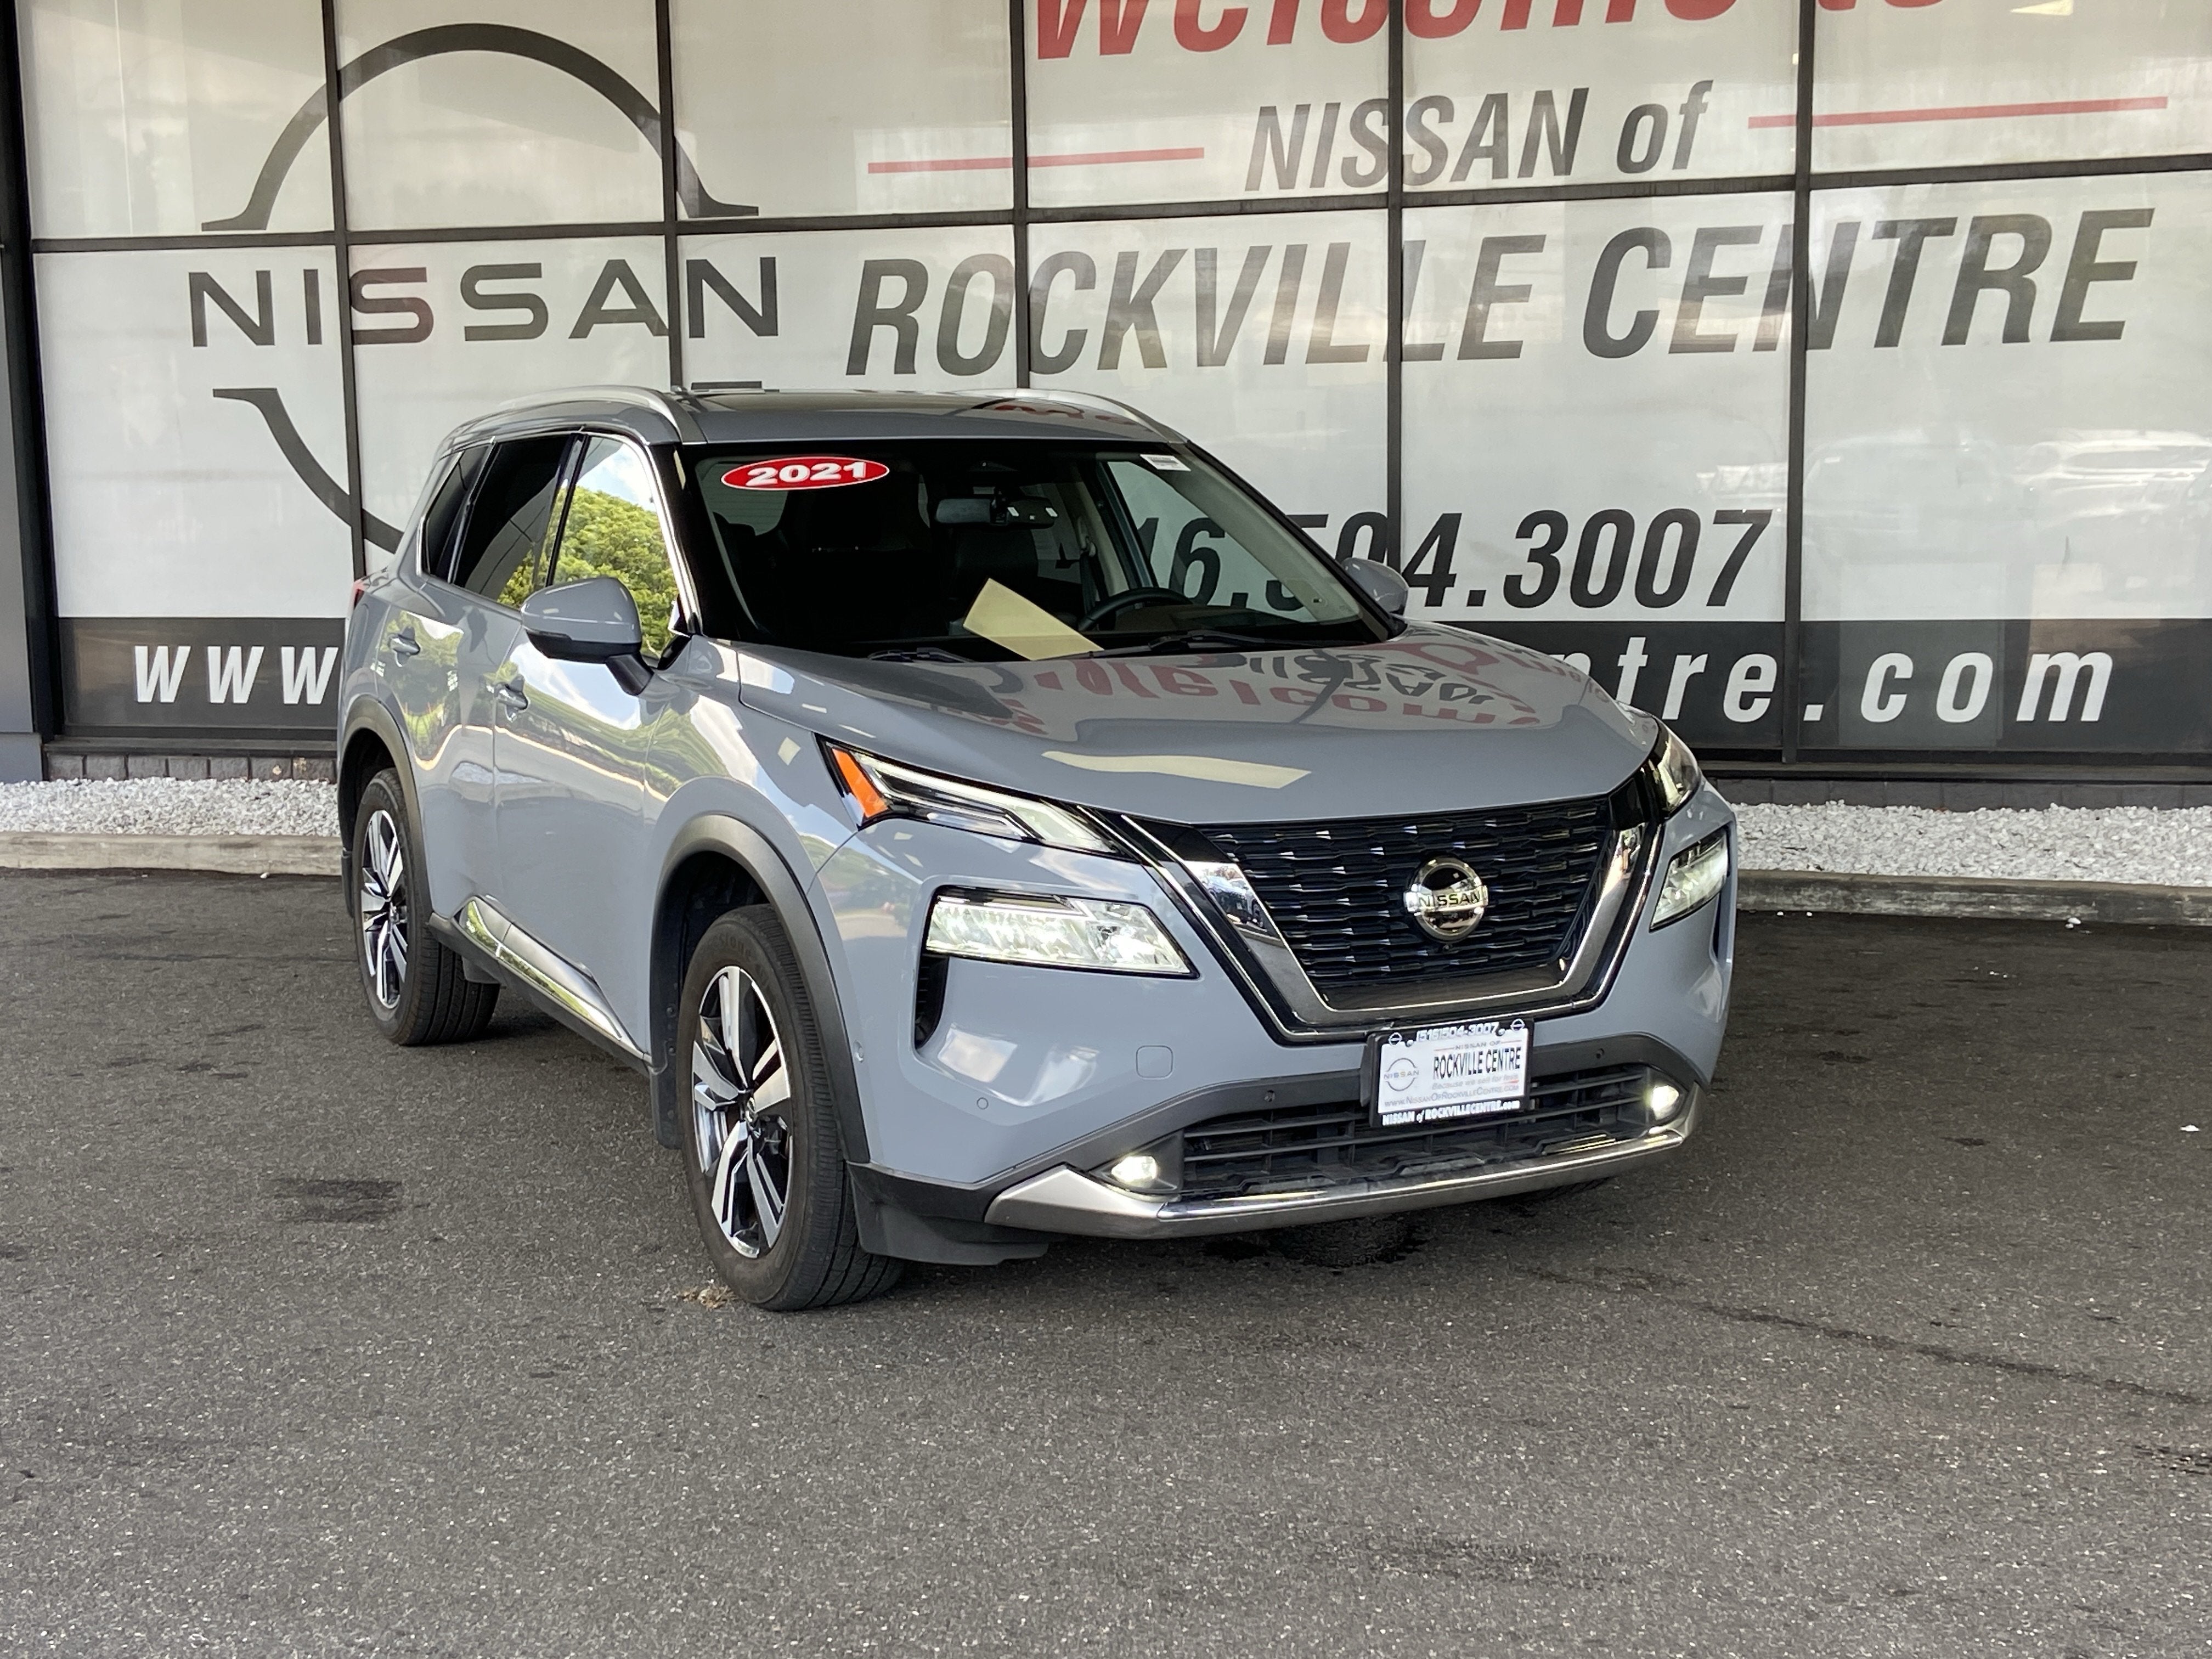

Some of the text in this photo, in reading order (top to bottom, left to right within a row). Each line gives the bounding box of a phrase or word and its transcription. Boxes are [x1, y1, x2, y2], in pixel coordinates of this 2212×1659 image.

[1244, 80, 1714, 192] NISSAN of
[189, 257, 778, 347] NISSAN
[845, 208, 2155, 376] ROCKVILLE CENTRE
[746, 461, 867, 487] 2021
[1418, 890, 1481, 908] NISSAN
[1383, 1070, 1419, 1080] NISSAN
[1432, 1046, 1522, 1080] ROCKVILLE CENTRE
[1382, 1111, 1415, 1126] NISSAN
[1416, 1110, 1425, 1124] of
